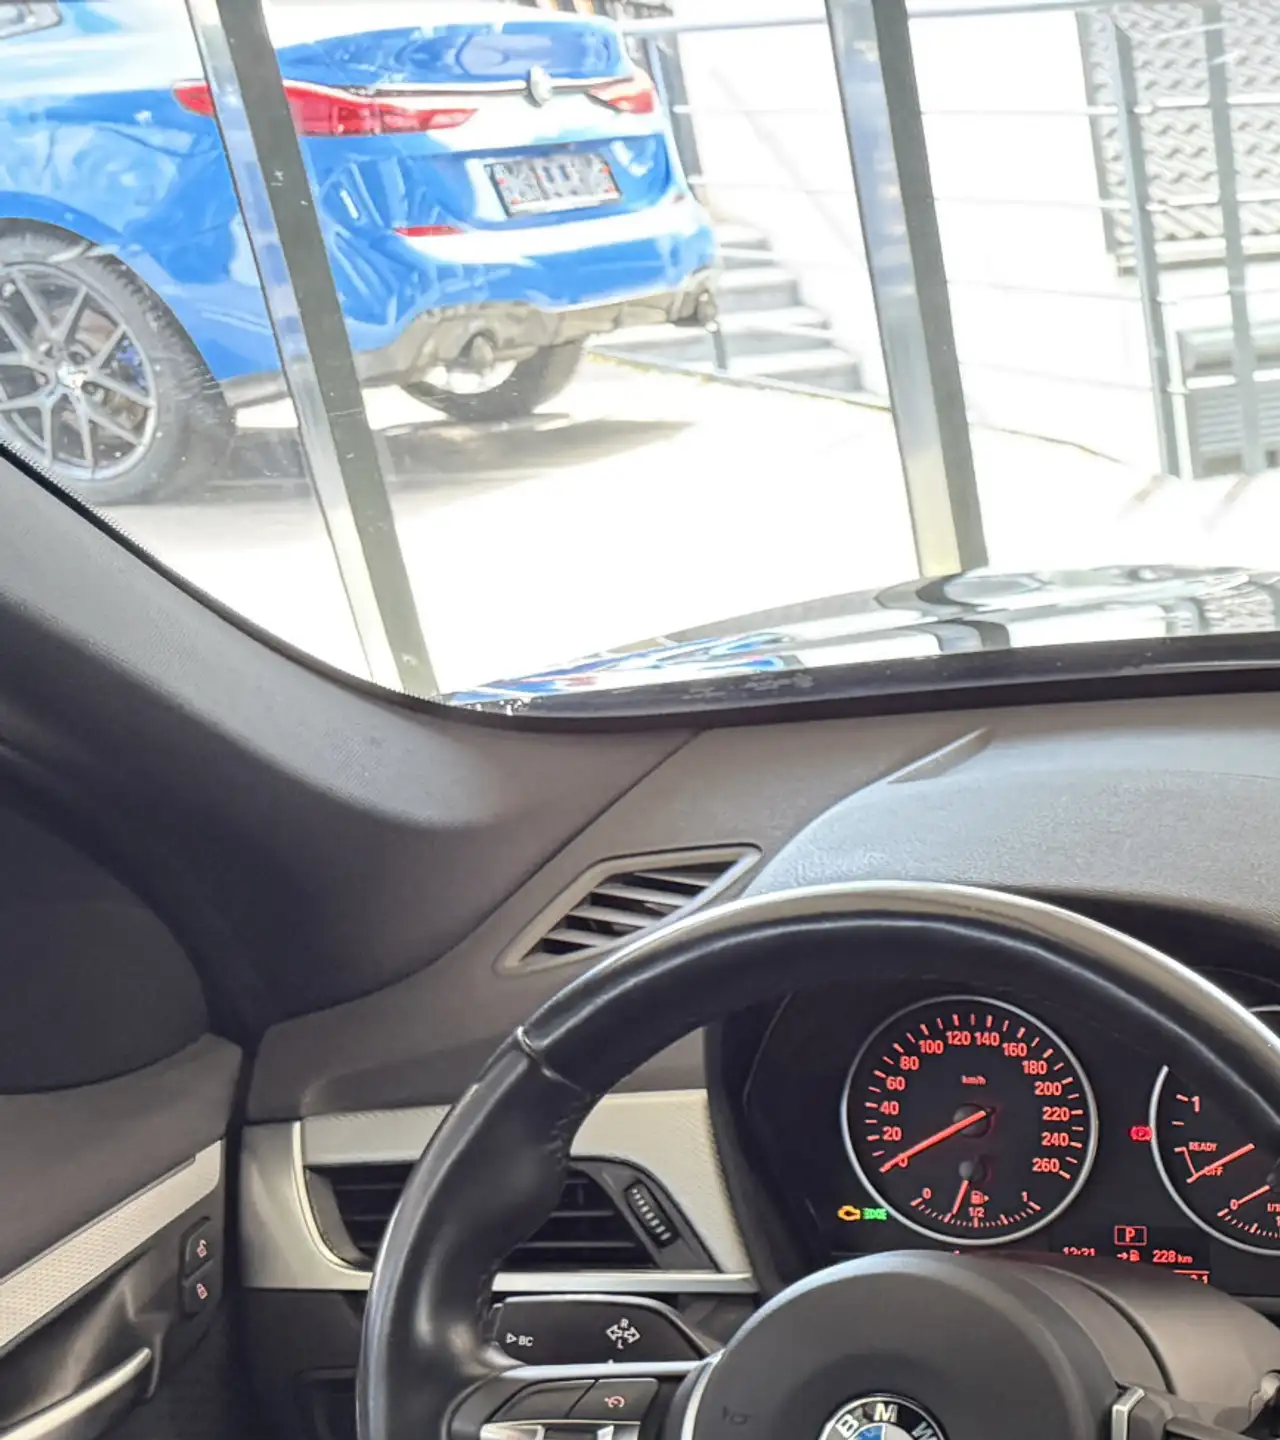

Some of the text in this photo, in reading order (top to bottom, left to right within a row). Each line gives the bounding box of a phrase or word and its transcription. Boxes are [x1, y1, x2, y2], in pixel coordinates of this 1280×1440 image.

[945, 1031, 971, 1046] 120
[974, 1031, 1000, 1046] 140
[918, 1039, 944, 1054] 100
[1002, 1042, 1028, 1057] 160
[899, 1056, 920, 1070] 80
[1022, 1060, 1048, 1075] 180
[886, 1076, 906, 1091] 60
[1034, 1081, 1062, 1096] 200
[879, 1101, 899, 1115] 40
[1191, 1096, 1200, 1112] 1
[1042, 1106, 1070, 1121] 220
[883, 1126, 902, 1141] 20
[1041, 1132, 1069, 1147] 240
[1189, 1142, 1217, 1152] READY
[1032, 1158, 1060, 1172] 260
[922, 1188, 932, 1200] 0
[1230, 1199, 1239, 1210] 0
[968, 1207, 985, 1218] 1/2
[1125, 1227, 1136, 1243] P
[1152, 1250, 1193, 1264] 228 km
[518, 1335, 534, 1347] BC
